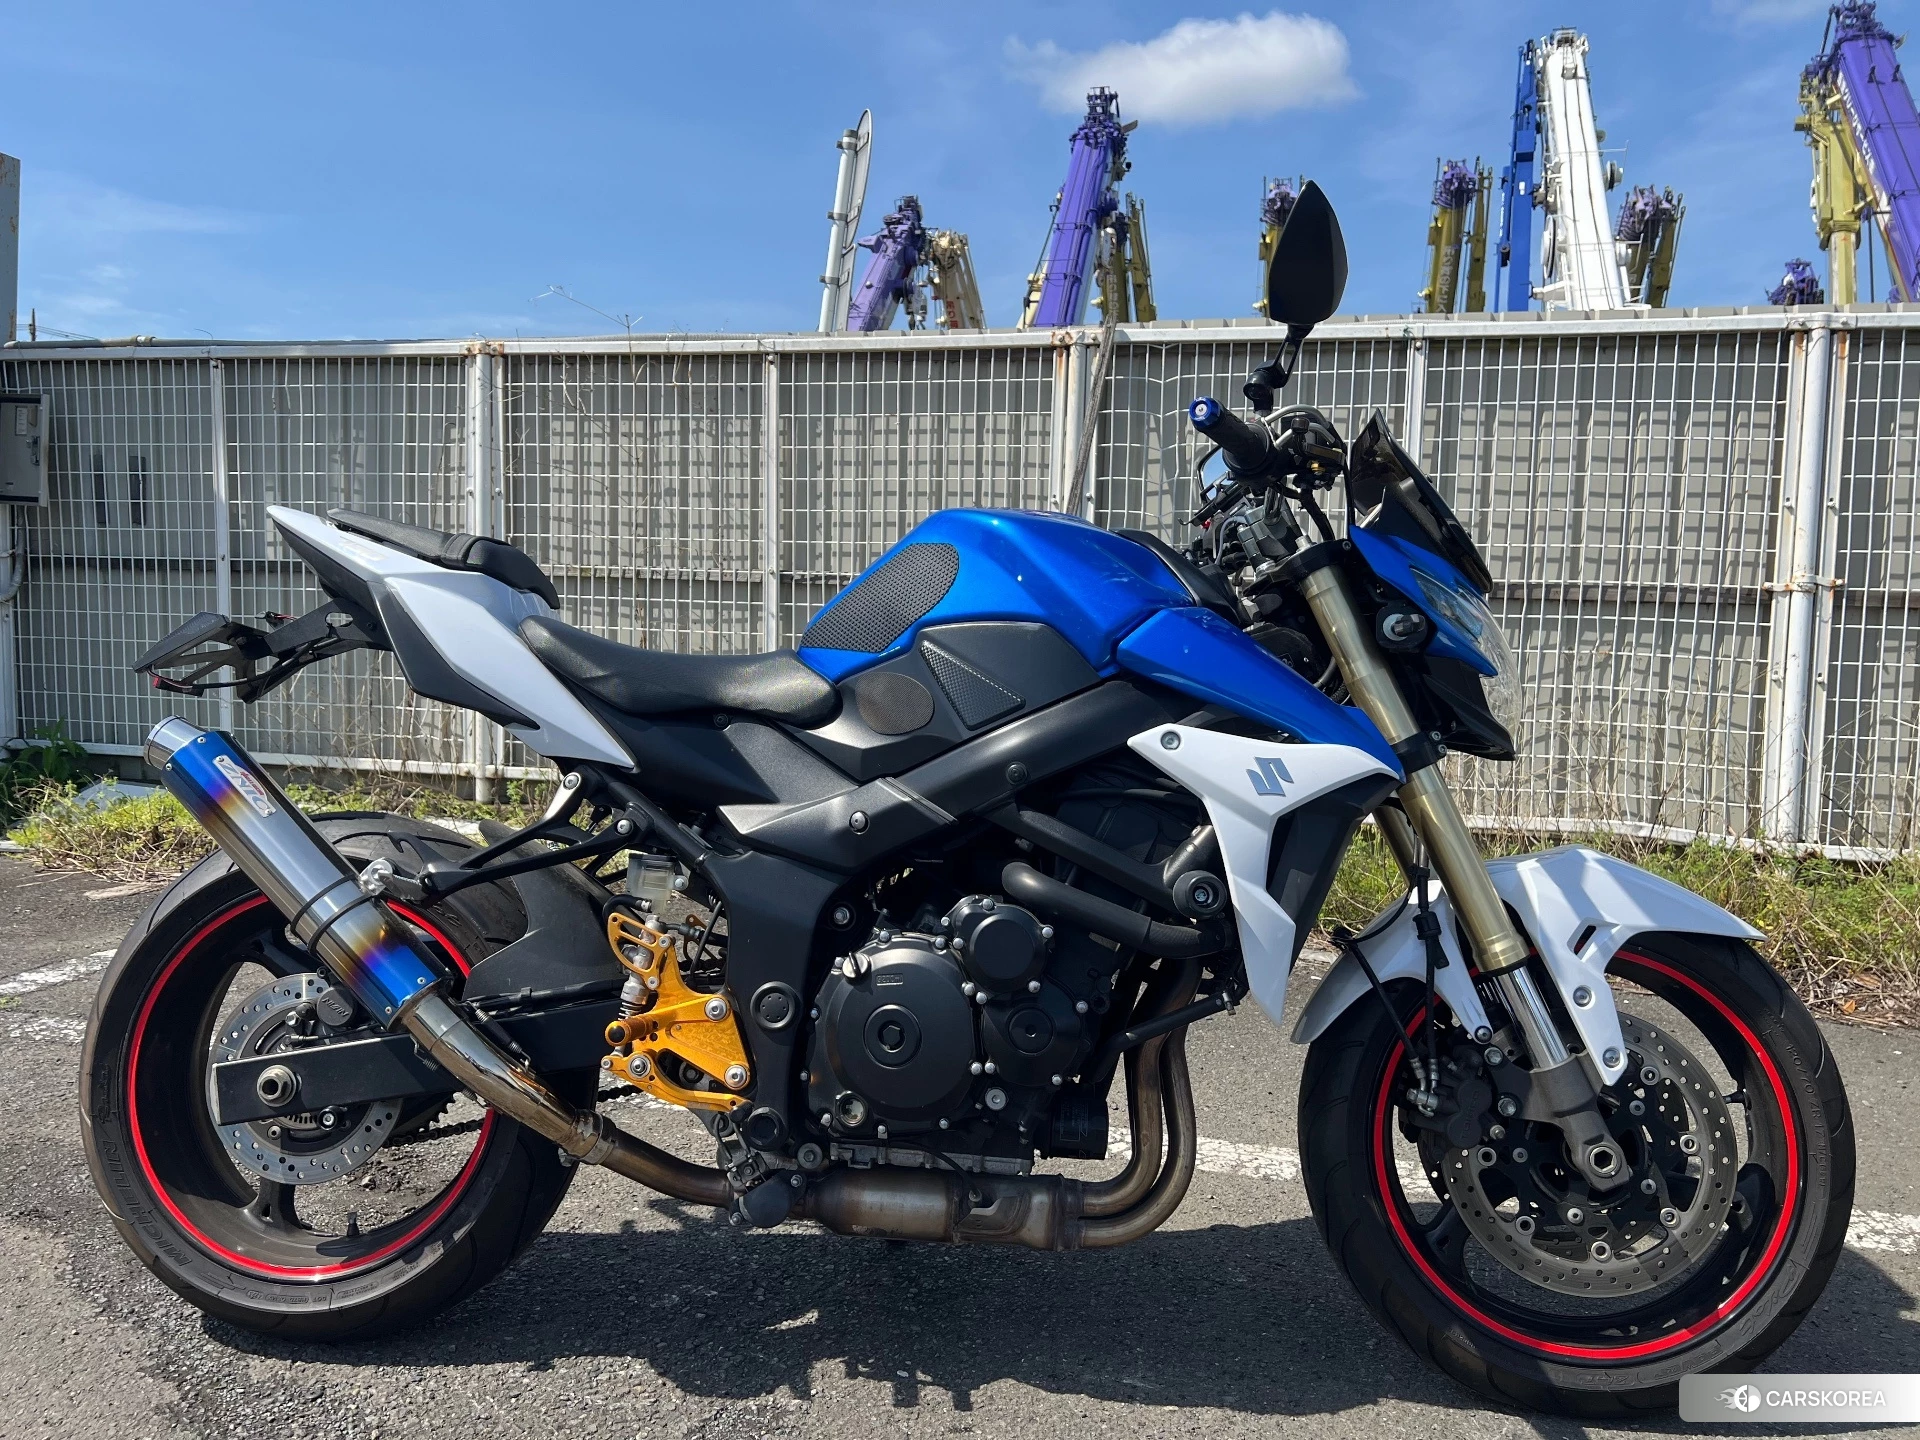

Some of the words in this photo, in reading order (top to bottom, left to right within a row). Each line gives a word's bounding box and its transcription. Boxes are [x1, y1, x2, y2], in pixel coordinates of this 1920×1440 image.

[321, 997, 350, 1017] NISSIN
[1785, 1043, 1816, 1095] 120/70
[1809, 1101, 1822, 1119] ZR
[1813, 1122, 1826, 1138] 17
[103, 1140, 193, 1267] MICHELIN
